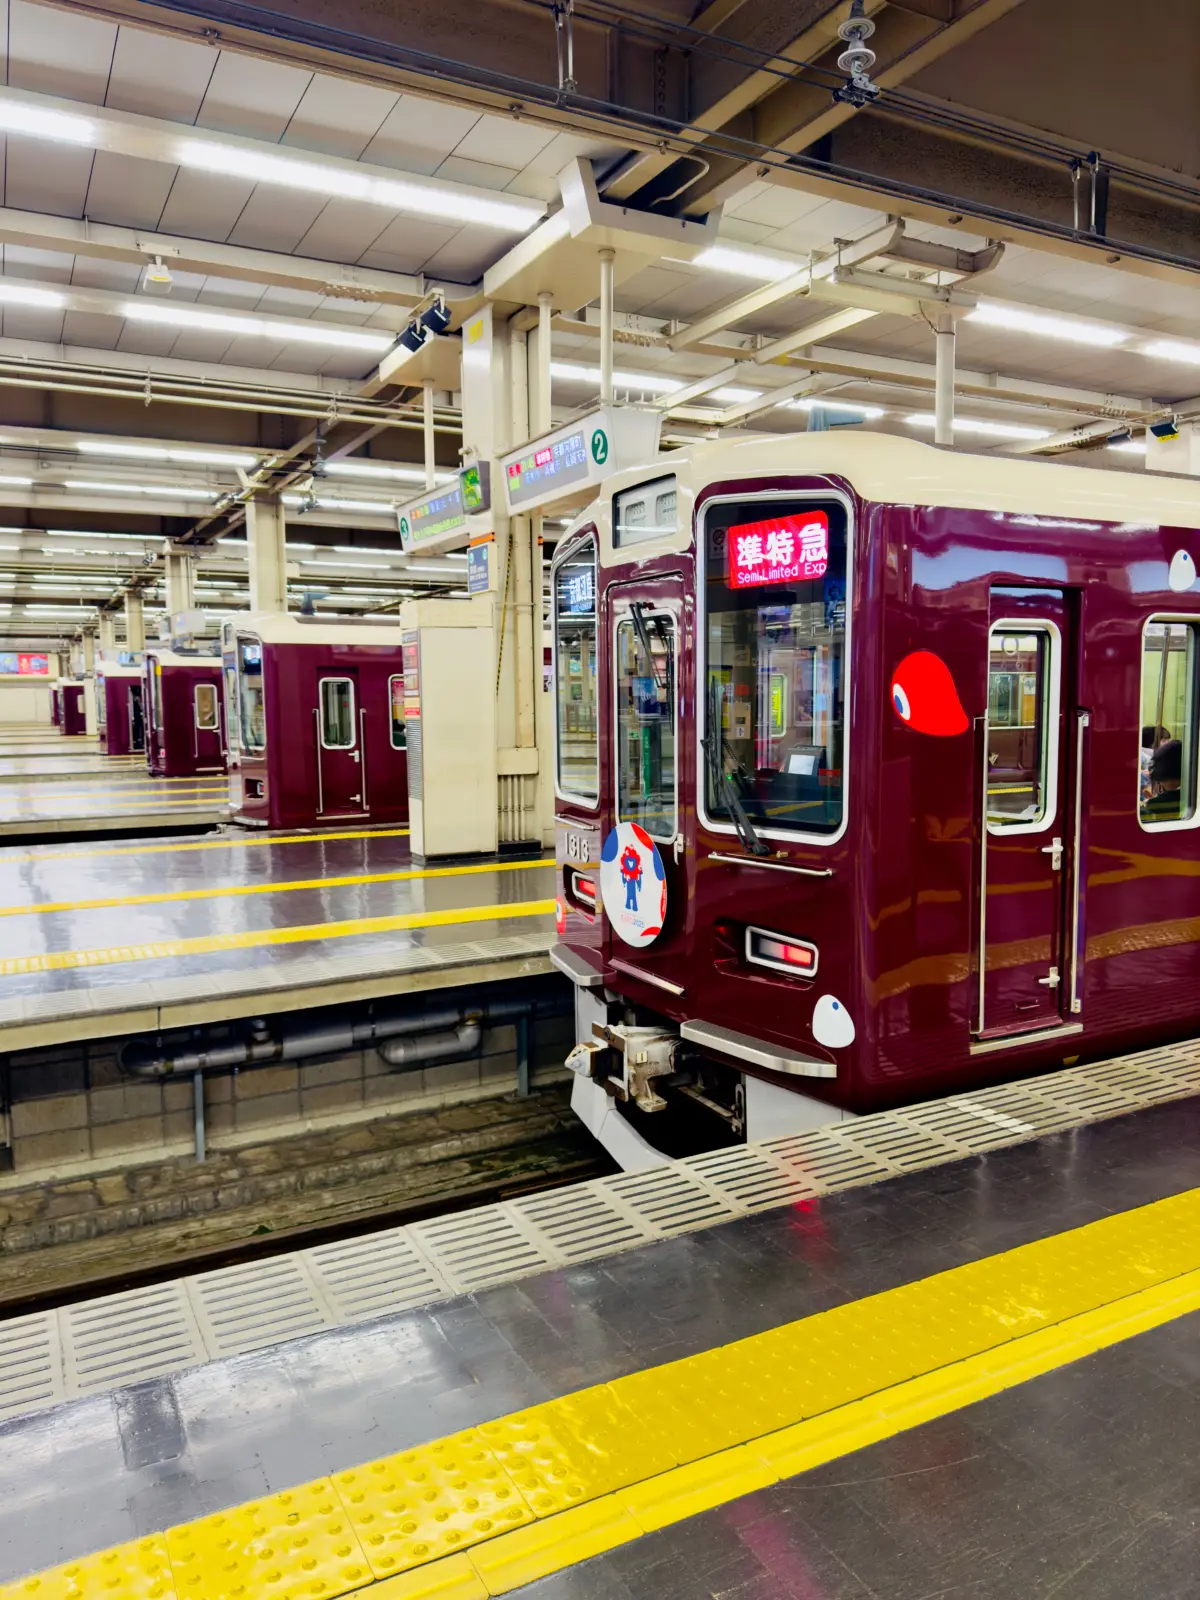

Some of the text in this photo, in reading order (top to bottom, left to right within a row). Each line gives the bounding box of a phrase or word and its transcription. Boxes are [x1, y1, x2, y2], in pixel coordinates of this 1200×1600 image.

[594, 432, 606, 461] 2
[737, 522, 827, 571] 準特急
[804, 562, 827, 576] Exp
